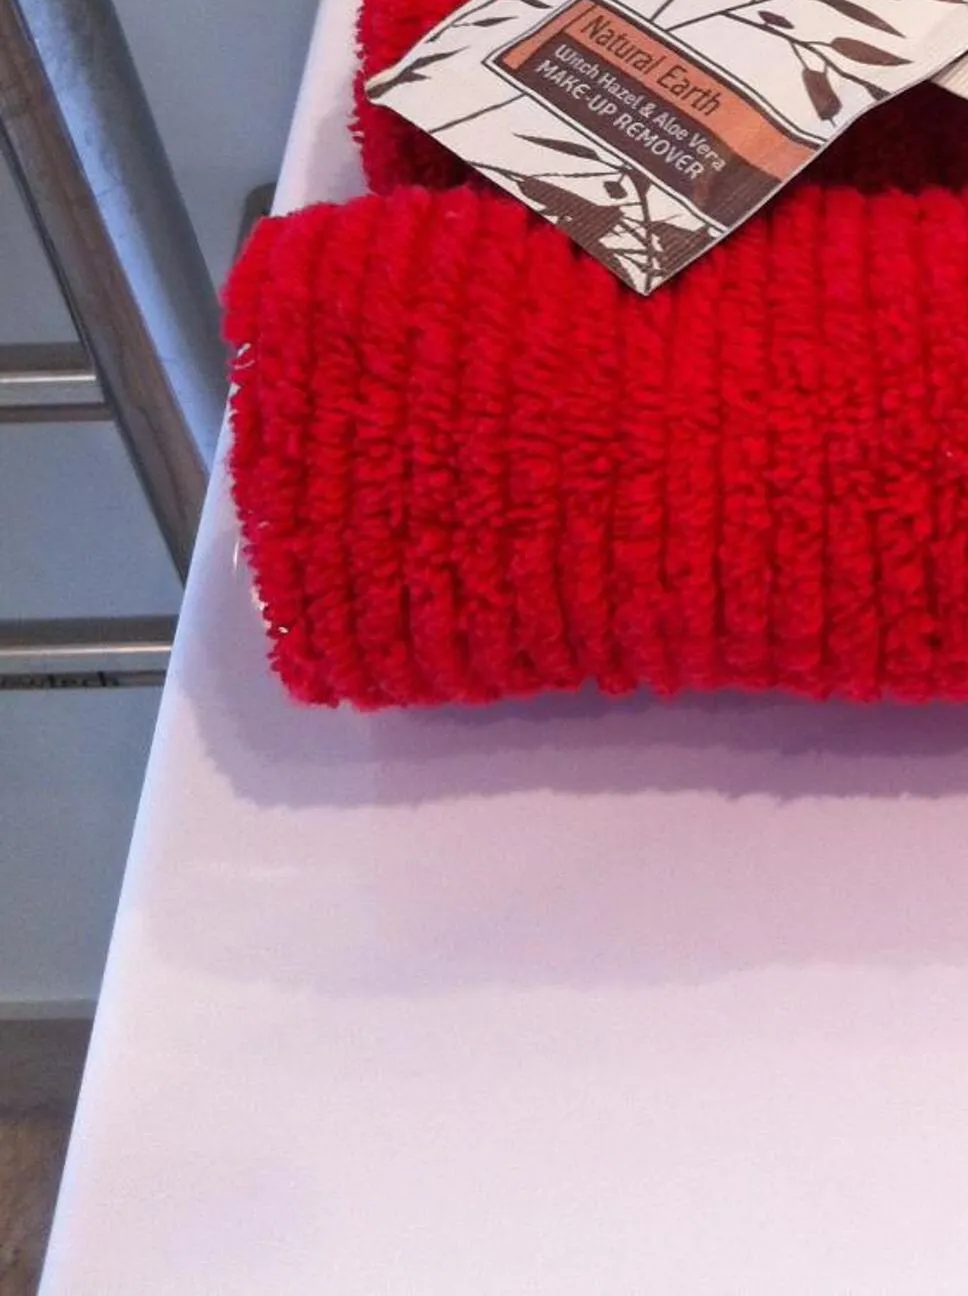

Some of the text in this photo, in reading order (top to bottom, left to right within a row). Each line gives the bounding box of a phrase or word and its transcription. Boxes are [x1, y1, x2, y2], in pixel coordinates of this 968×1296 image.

[536, 59, 705, 181] MAKE-UP REMOVER
[554, 44, 726, 173] Witch Hazel & Aloe Vera
[580, 14, 721, 118] Natural Earth
